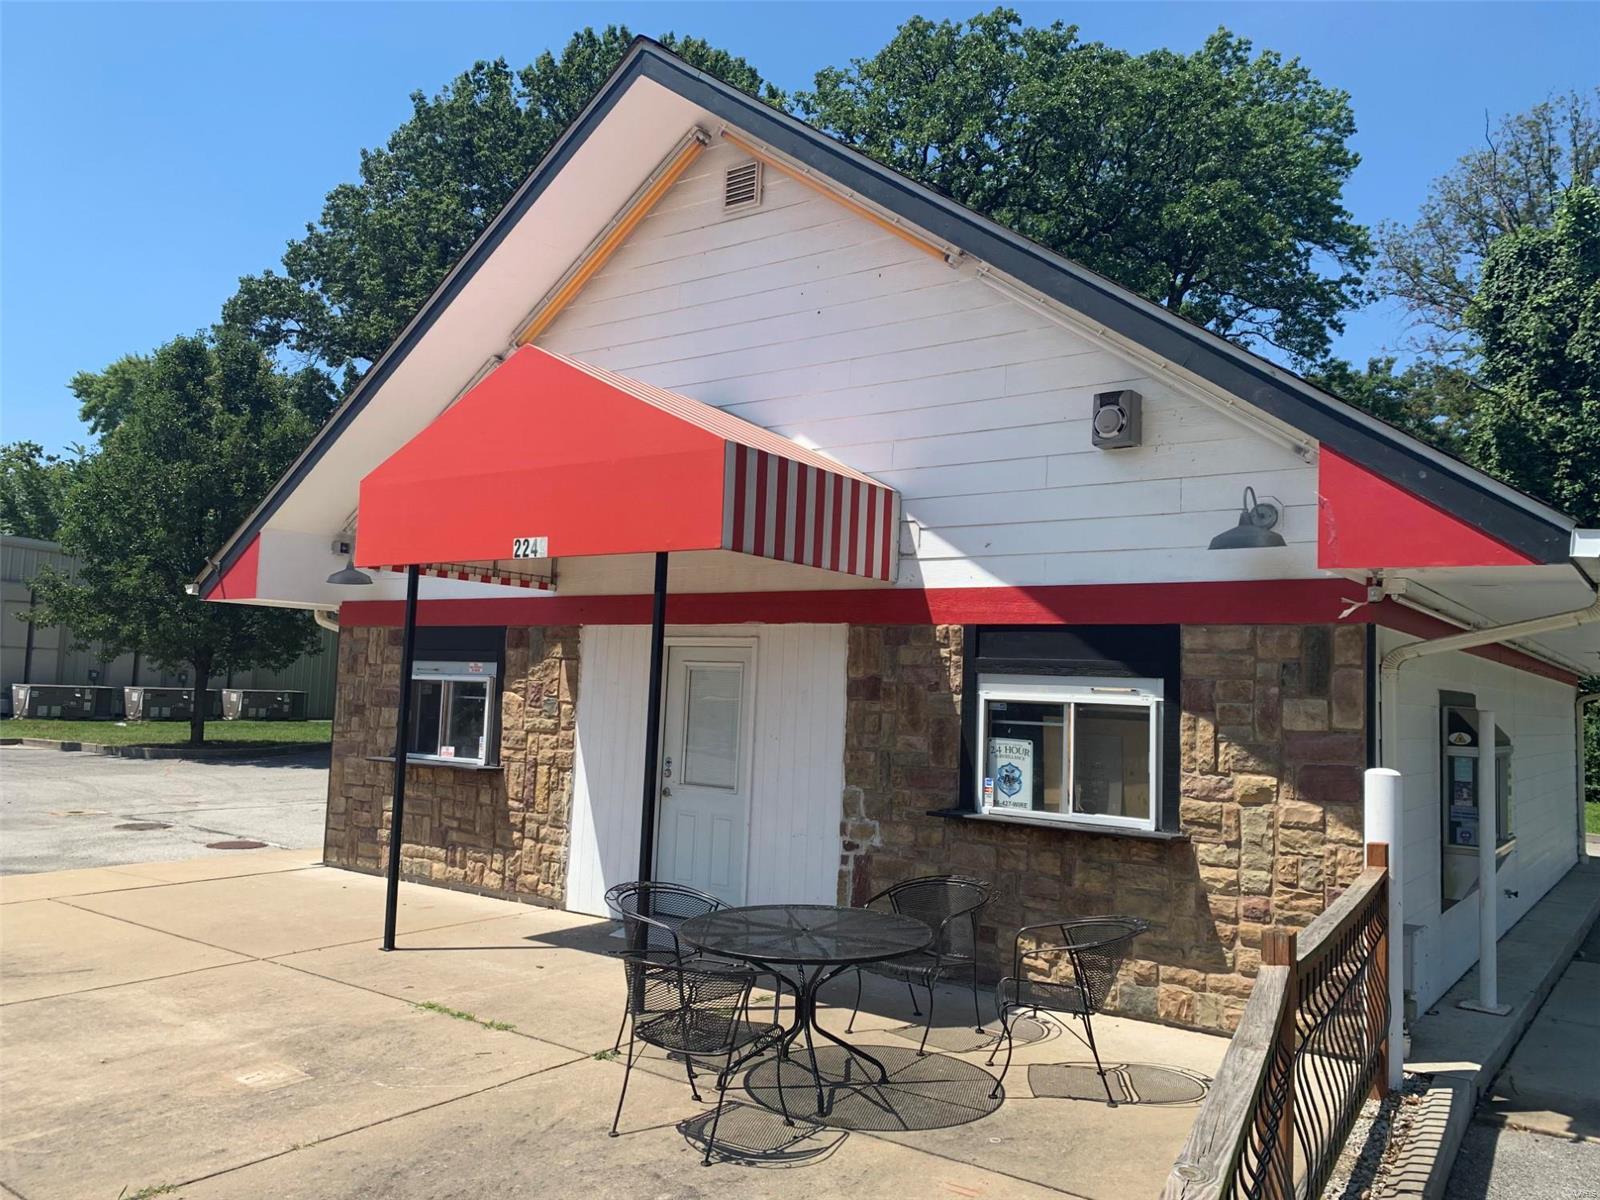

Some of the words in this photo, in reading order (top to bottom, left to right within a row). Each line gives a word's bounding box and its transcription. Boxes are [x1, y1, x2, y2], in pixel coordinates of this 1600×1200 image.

[514, 538, 538, 558] 224
[990, 745, 1002, 754] 24
[1004, 745, 1030, 757] HOUR
